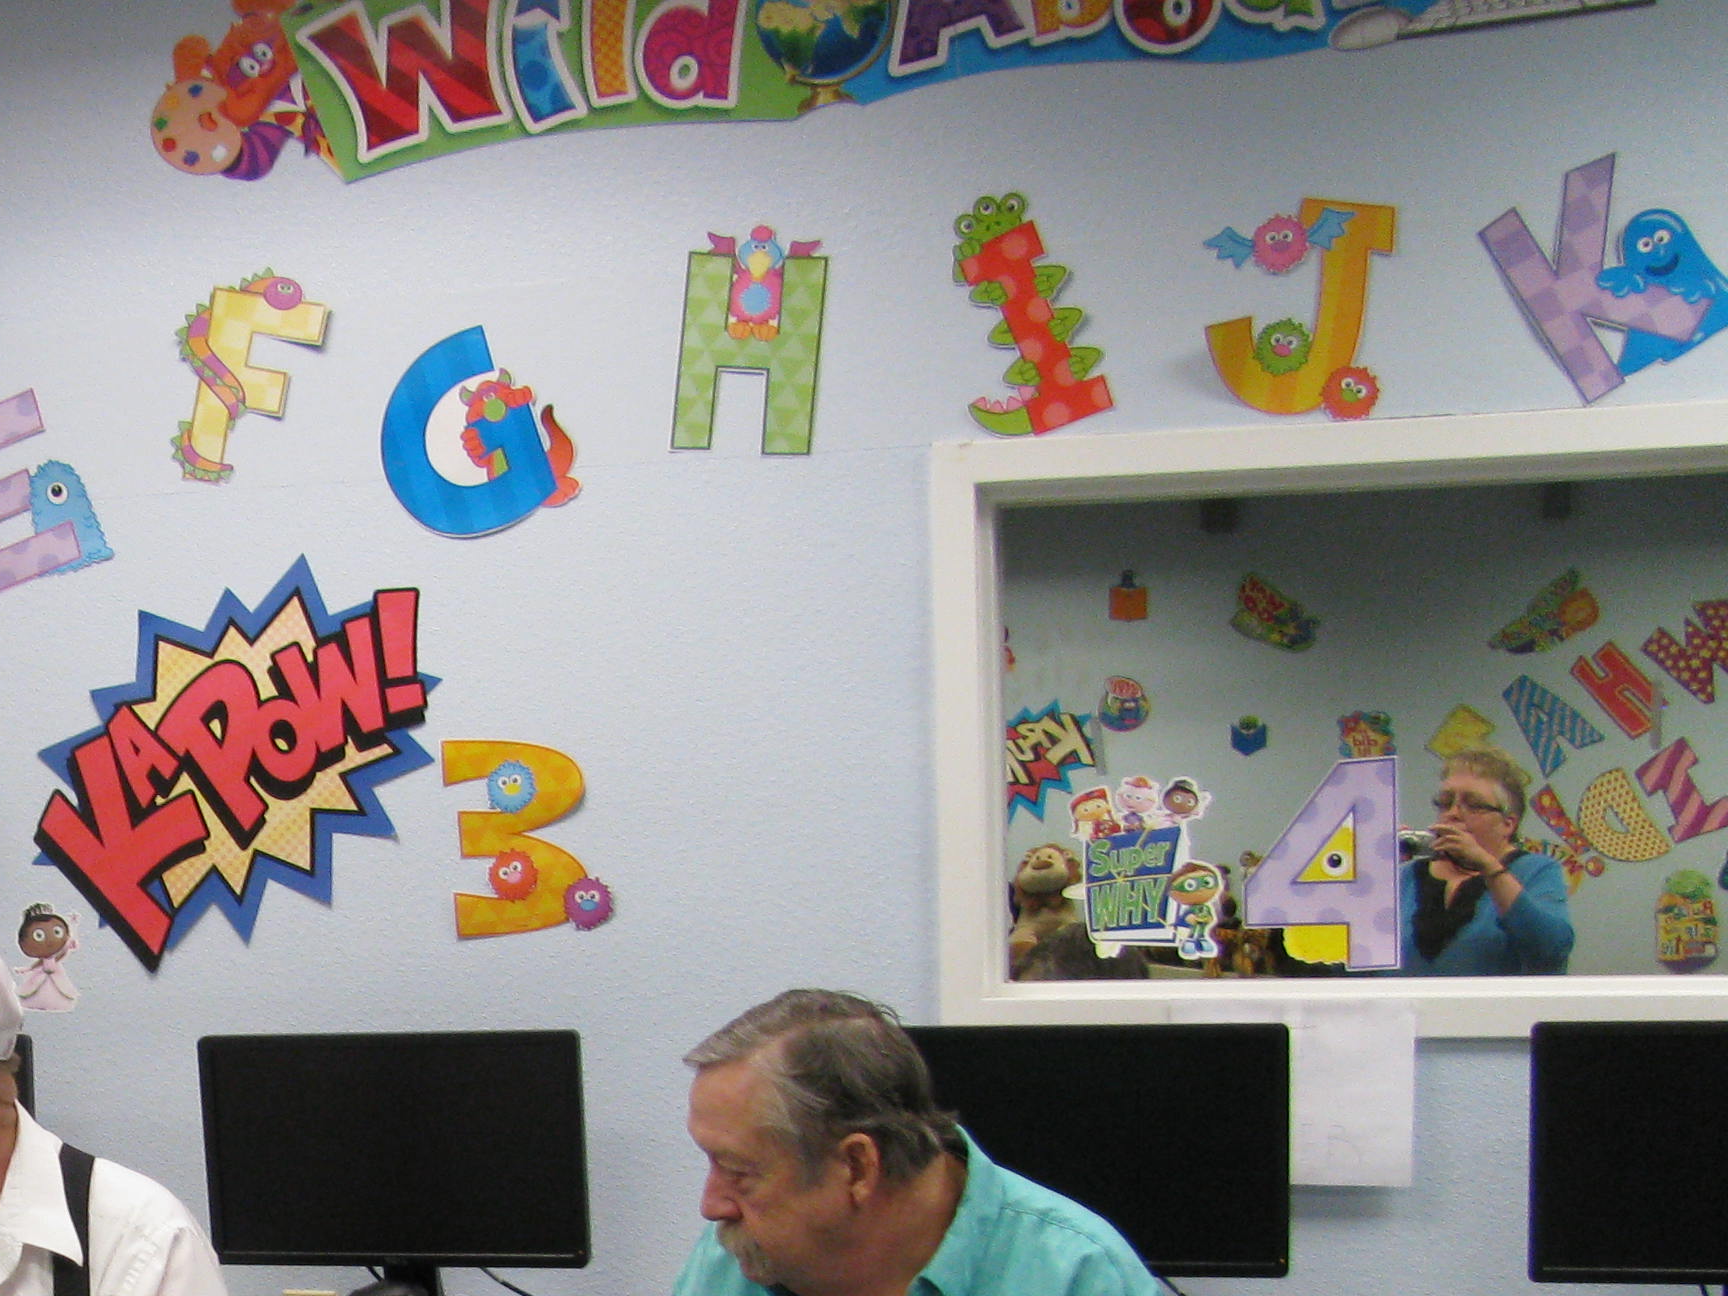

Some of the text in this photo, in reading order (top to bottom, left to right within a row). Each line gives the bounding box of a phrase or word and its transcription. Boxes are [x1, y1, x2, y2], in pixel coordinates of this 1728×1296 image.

[298, 0, 739, 162] Wild
[670, 251, 829, 456] H
[1205, 197, 1395, 415] J
[1477, 152, 1712, 405] K
[183, 285, 332, 482] F
[381, 325, 557, 538] G
[35, 587, 428, 974] KAPOW!
[440, 740, 588, 940] 3
[1088, 839, 1169, 877] Super
[1243, 756, 1401, 970] 4
[1091, 877, 1168, 930] WHY
